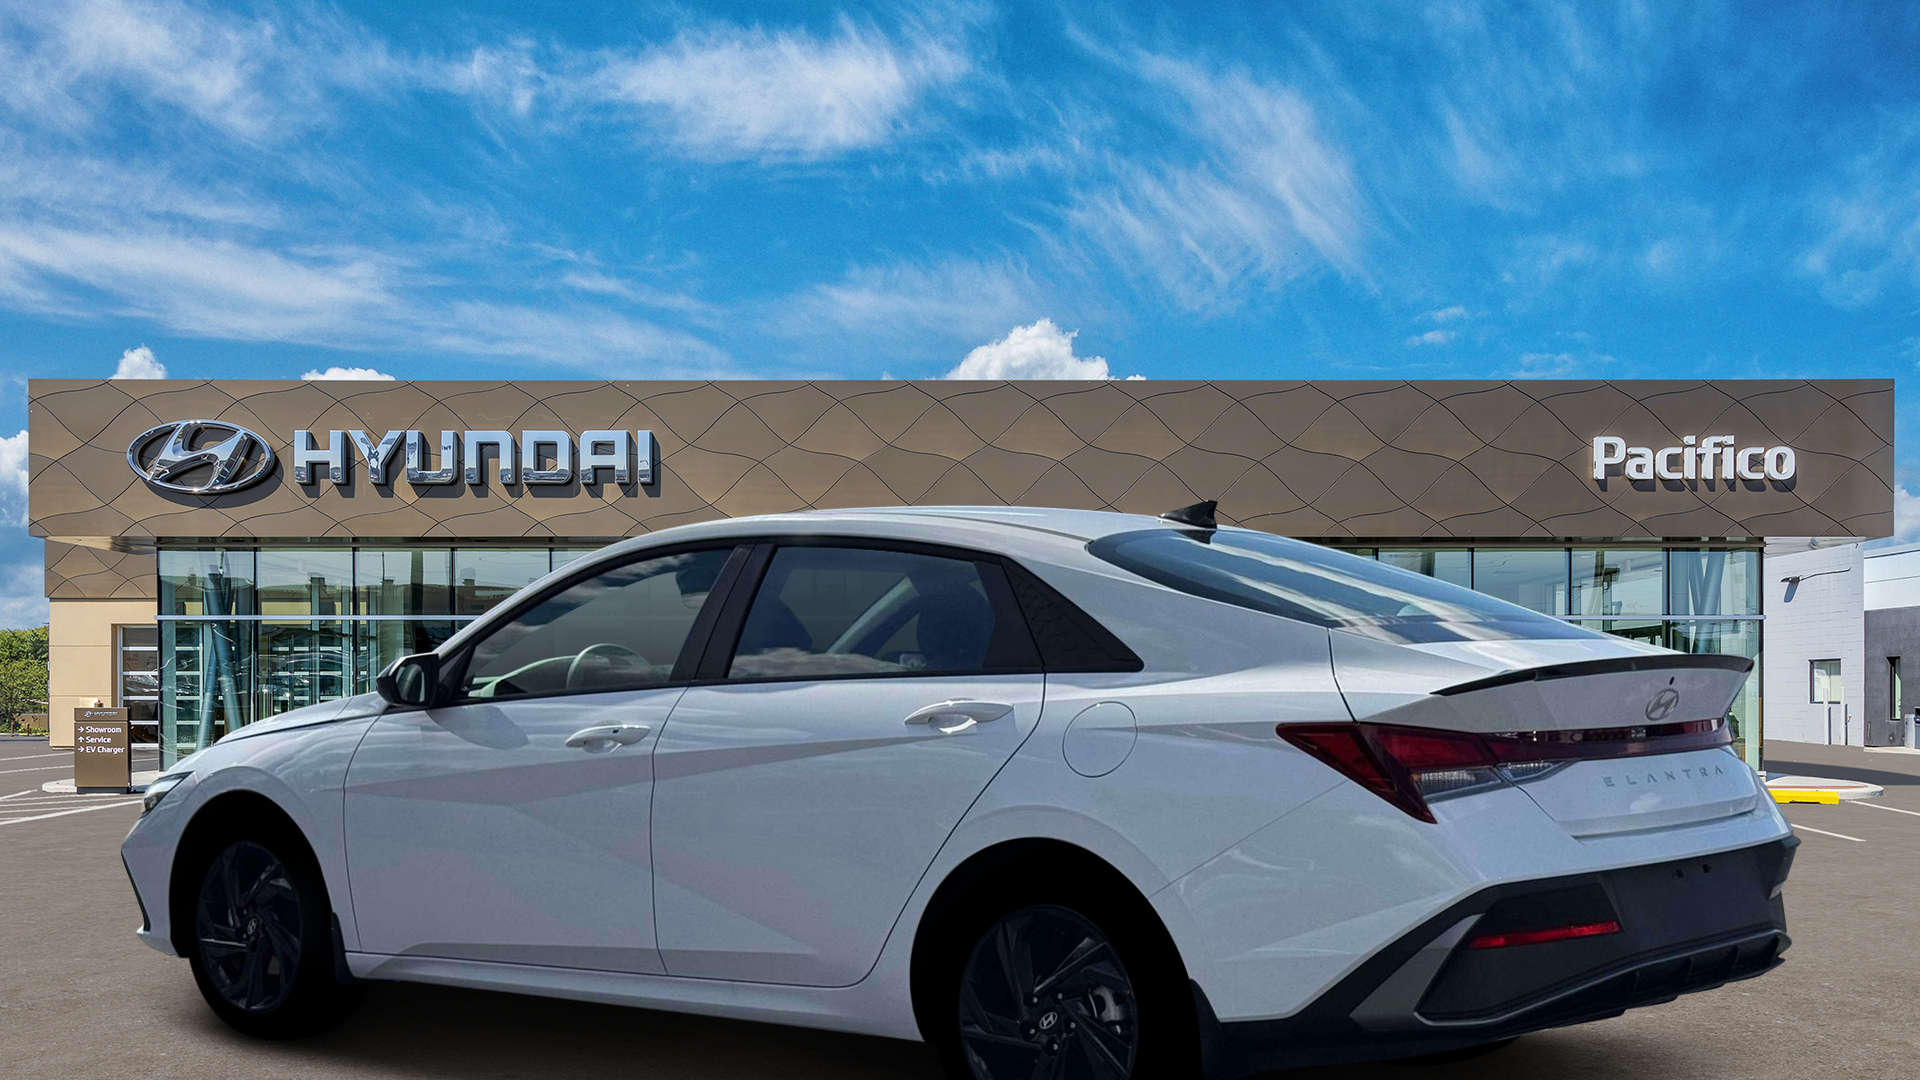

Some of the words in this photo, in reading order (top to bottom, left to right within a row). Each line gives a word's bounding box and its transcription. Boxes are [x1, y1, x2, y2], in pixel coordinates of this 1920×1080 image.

[294, 430, 654, 485] HYUNDAI
[1593, 434, 1796, 480] Pacifico
[97, 746, 125, 754] Charger
[1603, 764, 1724, 787] ELANTRA
